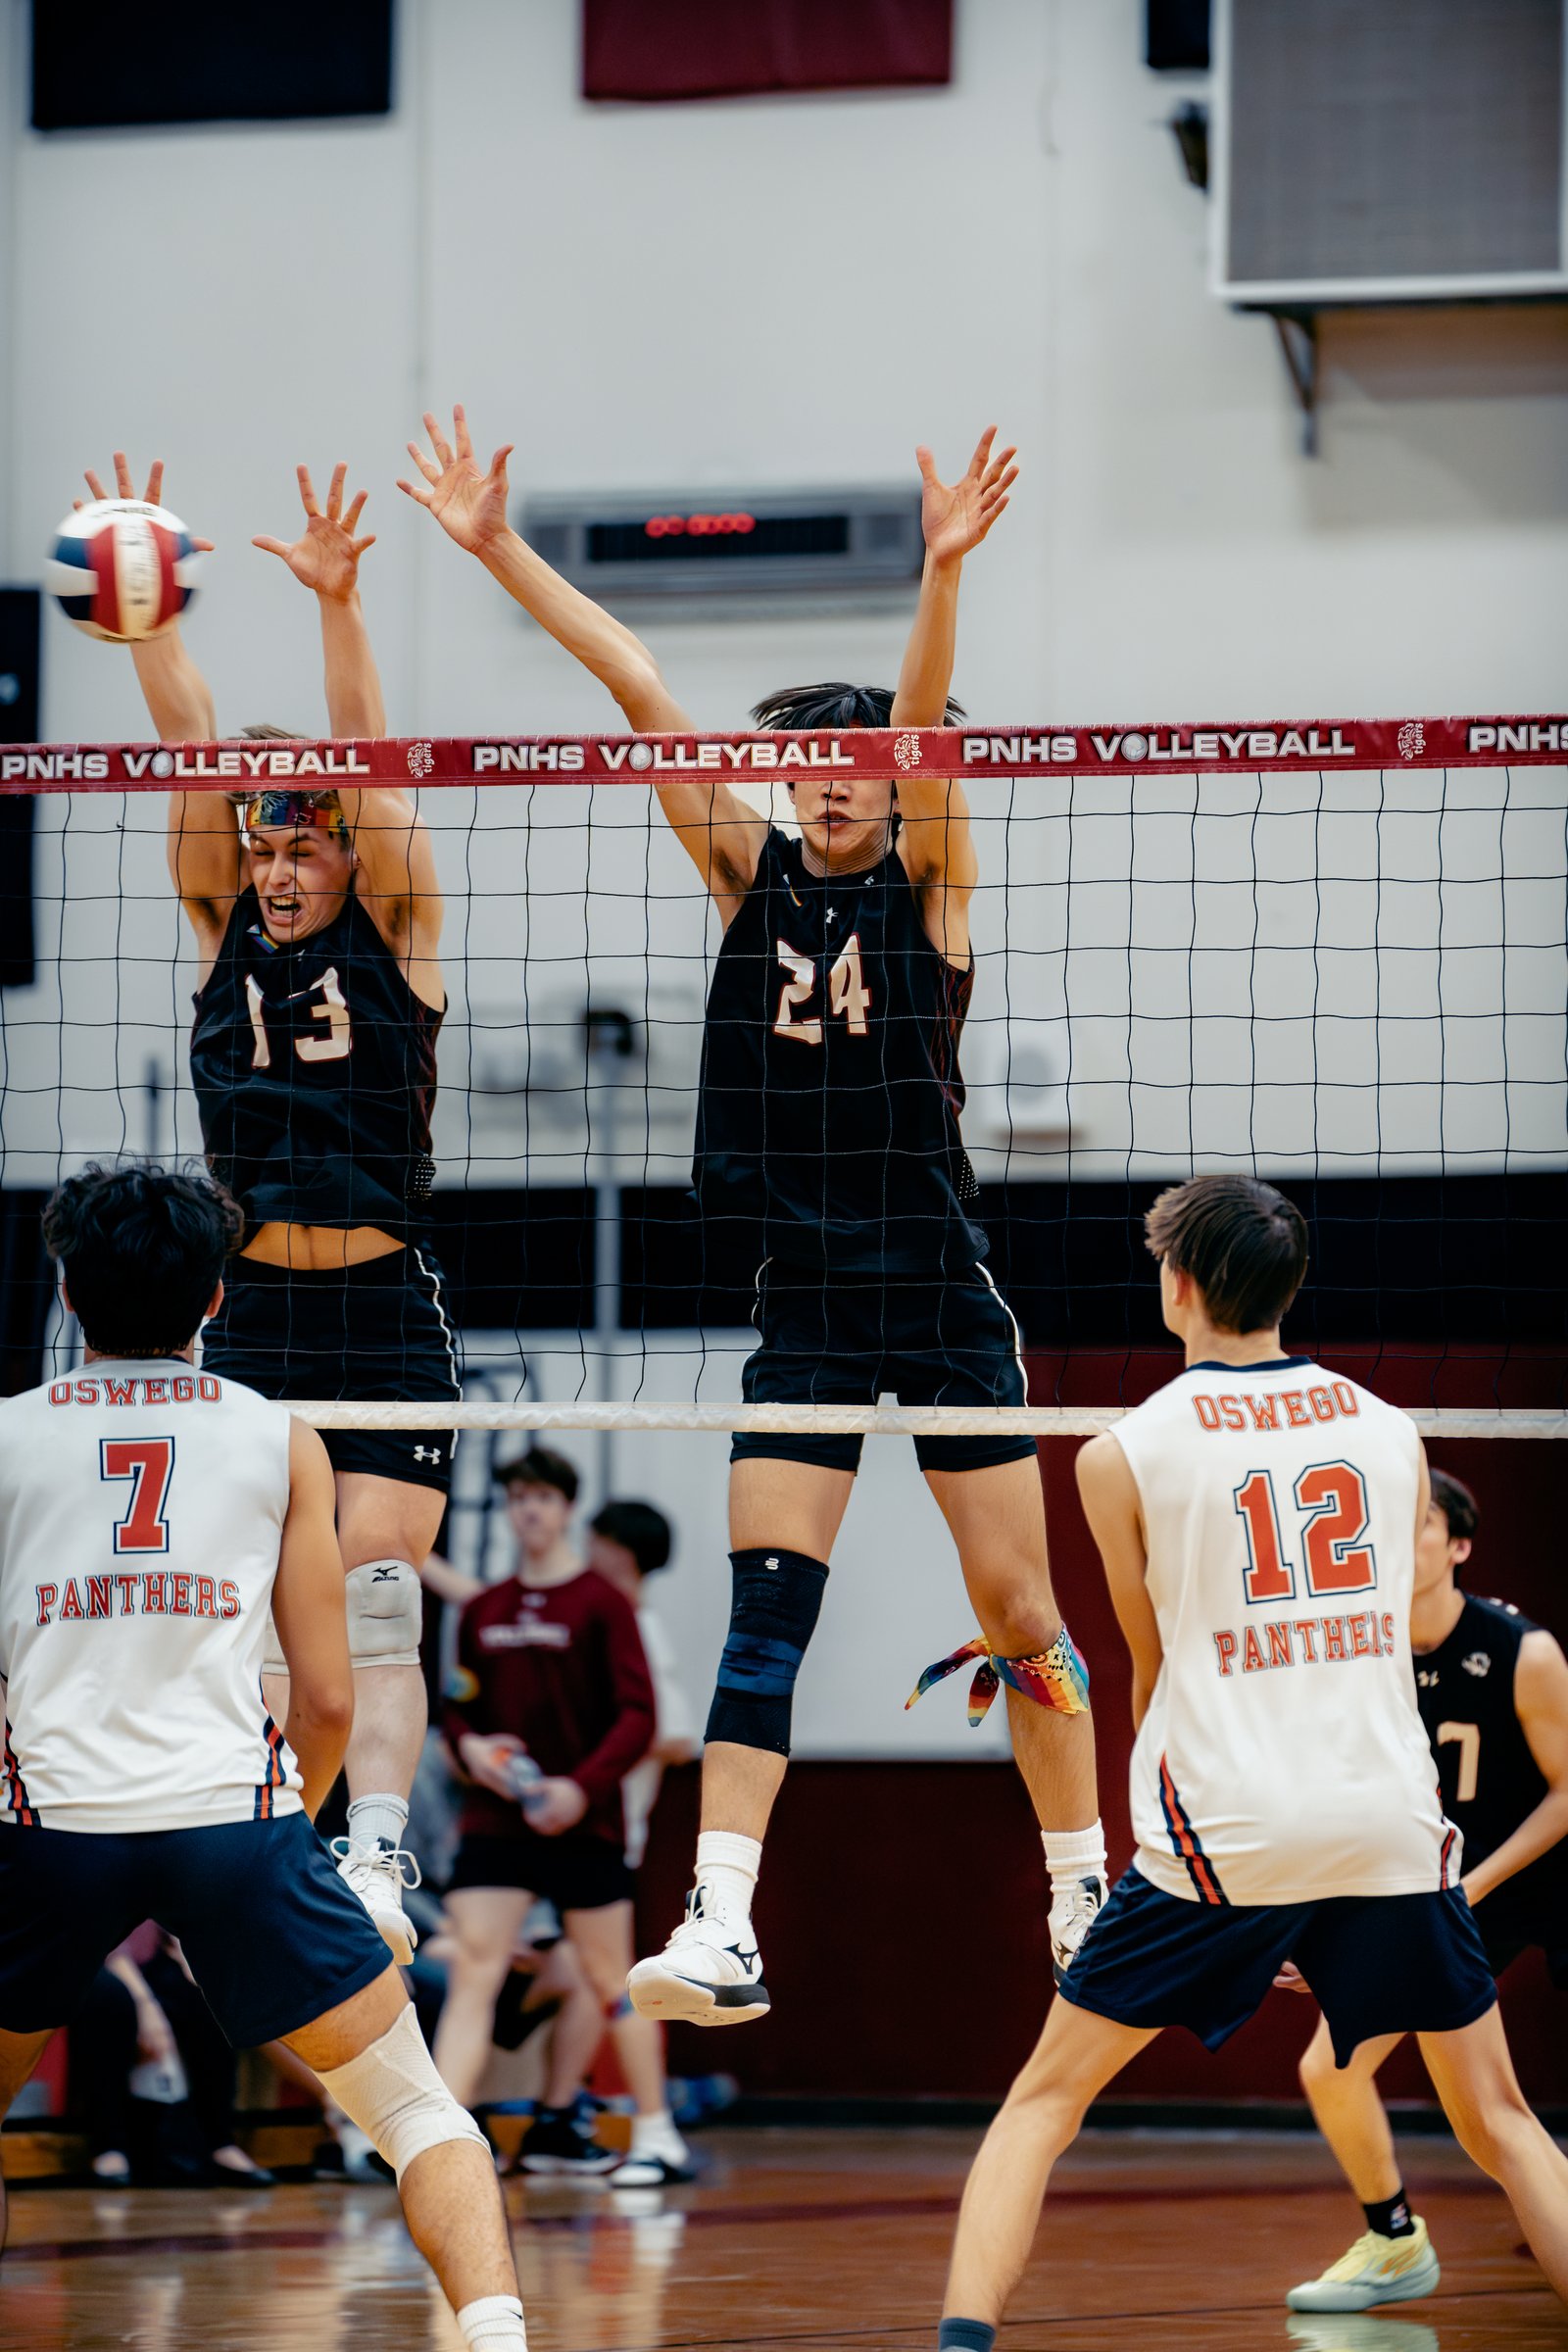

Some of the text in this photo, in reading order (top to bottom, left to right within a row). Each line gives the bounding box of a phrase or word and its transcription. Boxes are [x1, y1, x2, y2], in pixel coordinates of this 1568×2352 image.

[910, 734, 923, 765] tigers
[963, 730, 1356, 762] PNHS VOLLEYBALL
[1413, 722, 1426, 755] tigers
[1469, 723, 1568, 753] PNH
[2, 749, 370, 779] PNHS VOLLEYBALL
[423, 742, 435, 773] tigers
[474, 739, 854, 772] PNHS VOLLEYBALL
[772, 931, 873, 1046] 24
[245, 966, 353, 1069] 13
[48, 1377, 222, 1407] OSWEGO
[1192, 1382, 1360, 1433] OSWEGO
[99, 1436, 175, 1555] 7
[1233, 1459, 1378, 1605] 12
[35, 1572, 242, 1627] PANTHERS
